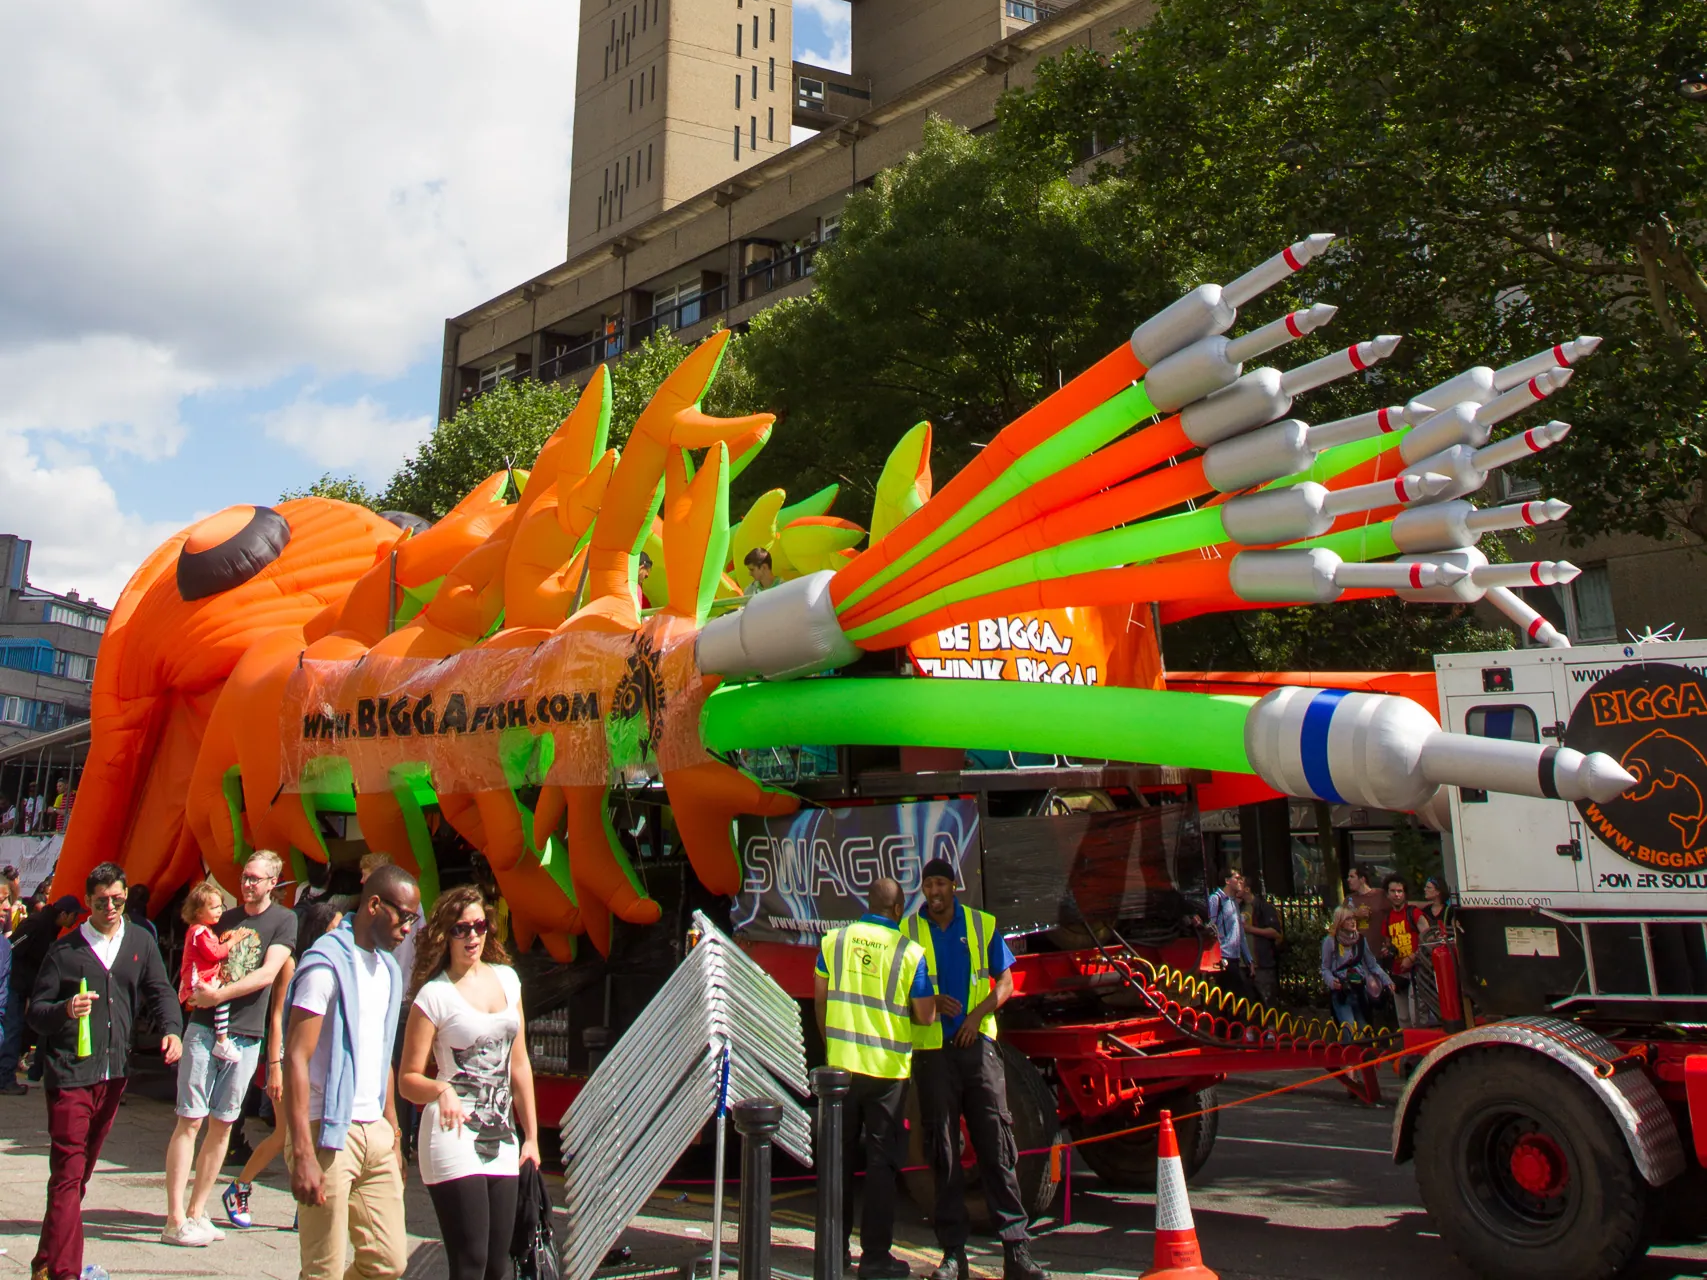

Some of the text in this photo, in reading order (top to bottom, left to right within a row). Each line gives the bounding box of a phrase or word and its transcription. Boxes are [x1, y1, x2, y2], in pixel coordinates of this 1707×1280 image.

[937, 622, 970, 652] BE
[303, 691, 600, 739] WWW.BIGGAFISH.COM
[1590, 682, 1707, 726] BIGGA
[743, 832, 966, 897] SWAGGA
[1461, 894, 1552, 907] www.sdmo.com
[851, 937, 888, 950] SECURITY
